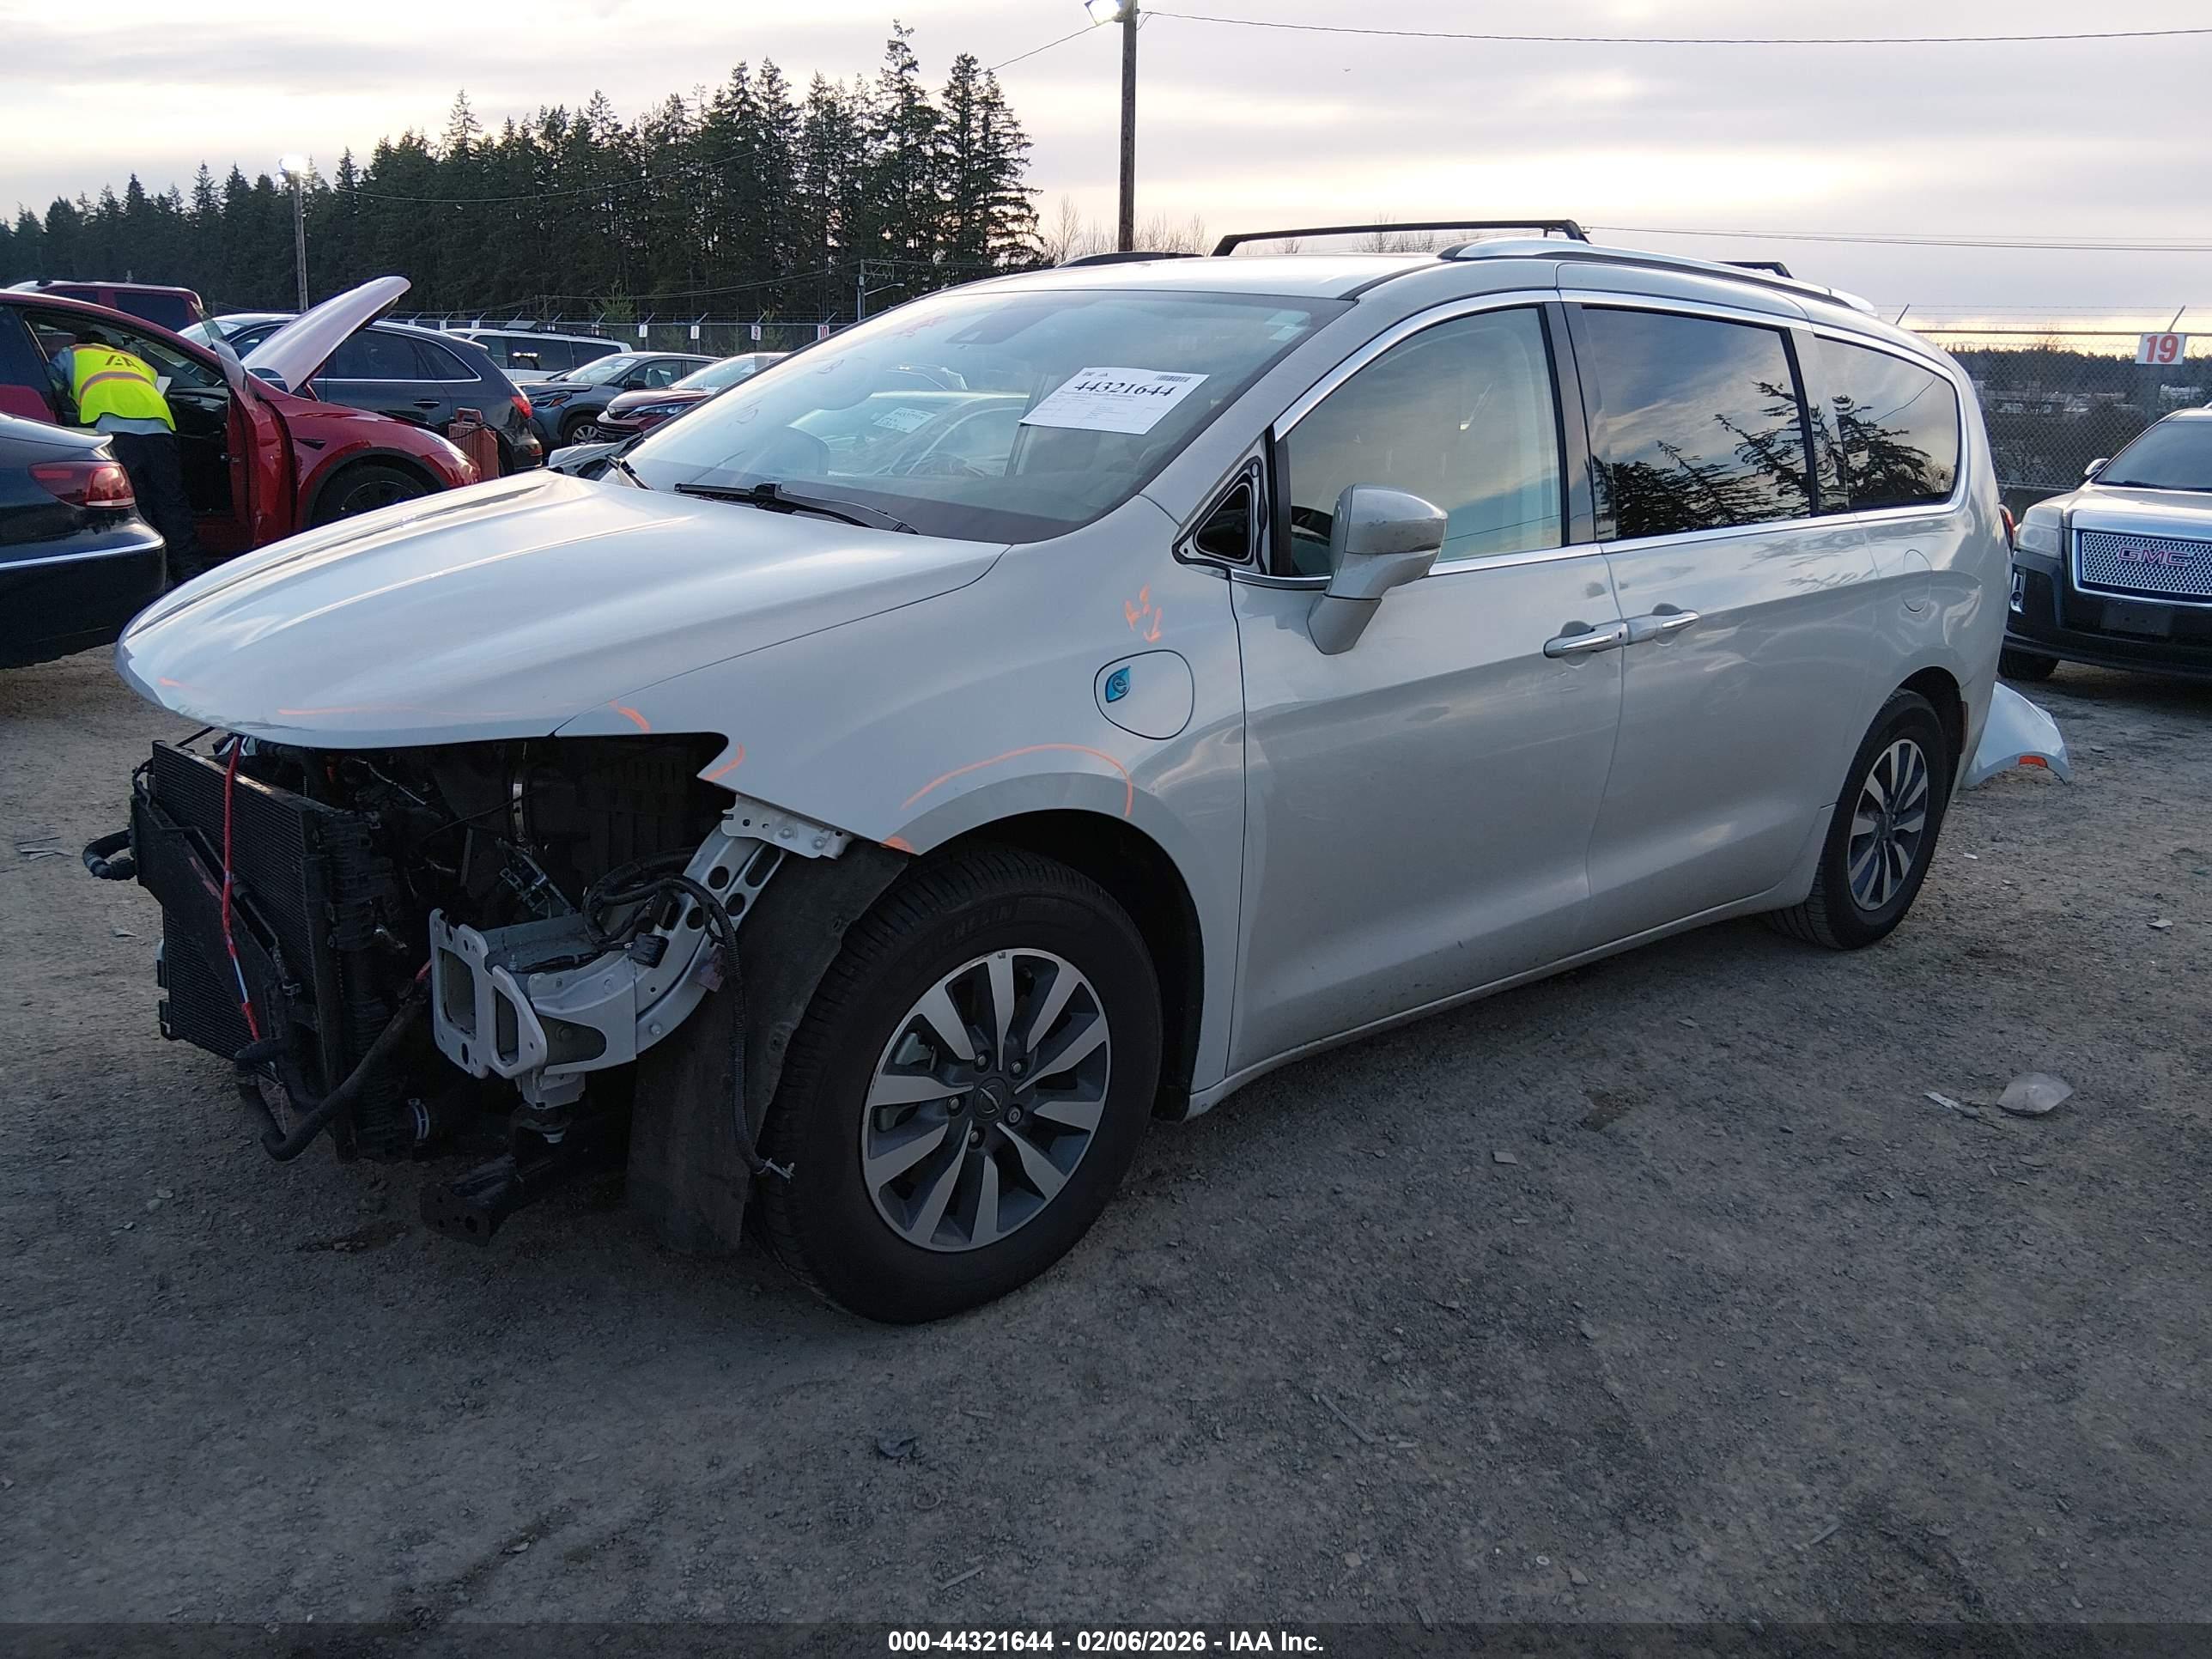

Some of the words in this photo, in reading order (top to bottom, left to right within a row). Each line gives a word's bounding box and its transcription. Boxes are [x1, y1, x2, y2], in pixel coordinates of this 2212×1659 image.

[2146, 334, 2179, 363] 19
[1074, 380, 1176, 397] 44321644
[2118, 544, 2191, 568] GMC
